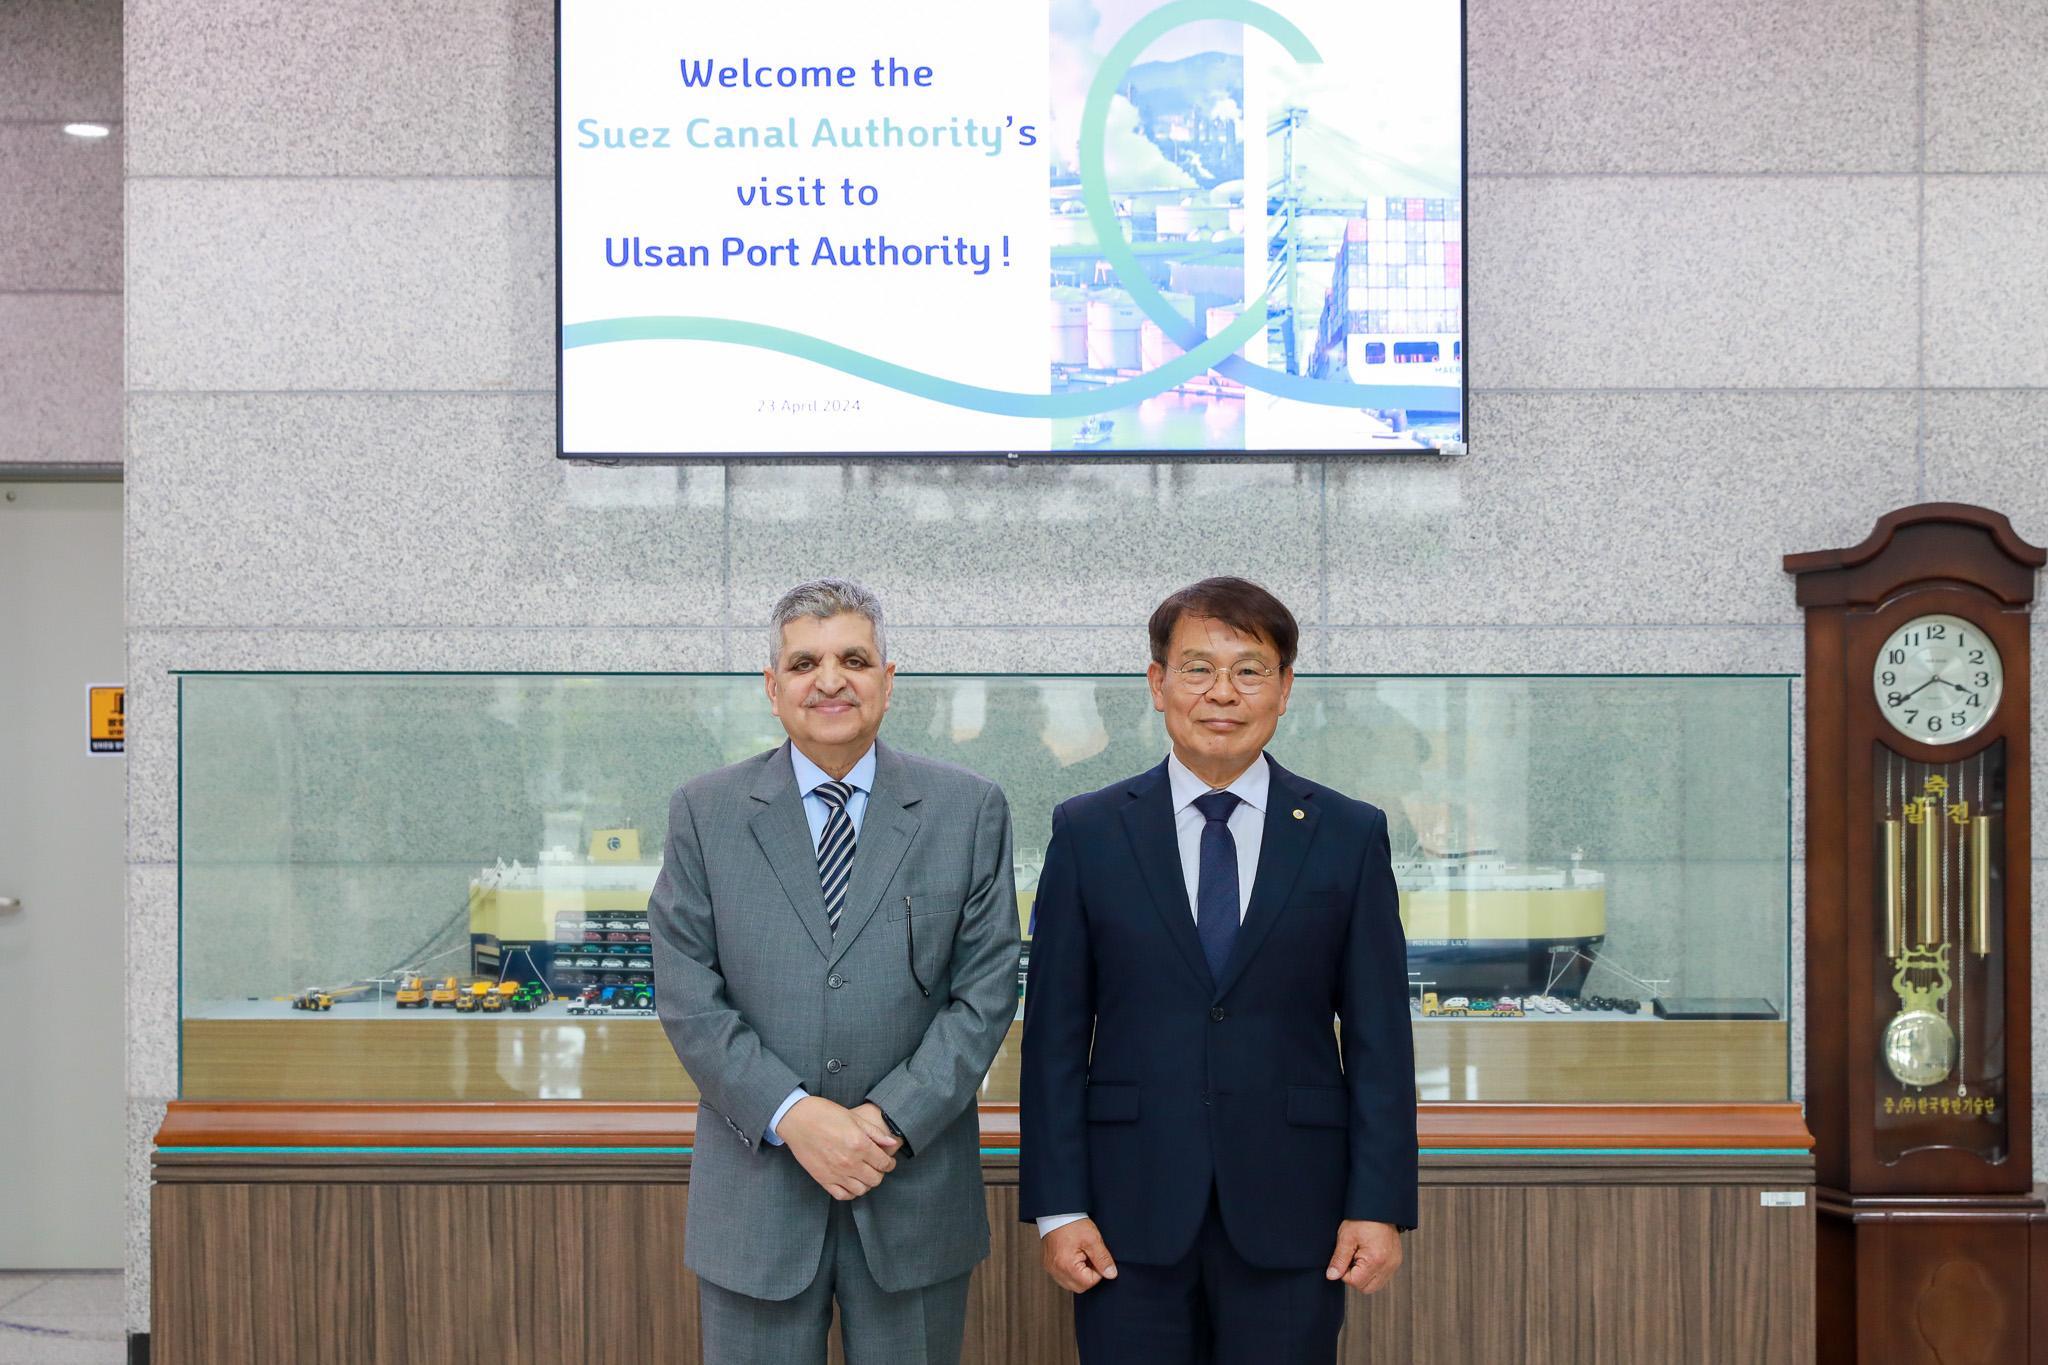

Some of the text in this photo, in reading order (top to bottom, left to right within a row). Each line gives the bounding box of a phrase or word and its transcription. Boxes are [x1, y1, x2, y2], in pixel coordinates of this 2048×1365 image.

[680, 57, 934, 89] Welcome the
[577, 115, 1037, 157] Suez Canal Authority's
[737, 176, 879, 206] visit to
[605, 236, 710, 268] Ulsan
[721, 237, 800, 268] Port
[757, 400, 861, 415] 23 April 2024
[1904, 632, 1919, 647] 11
[1926, 624, 1946, 640] 12
[1957, 632, 1965, 648] 1
[1889, 649, 1905, 665] 10
[1968, 650, 1985, 665] 2
[1881, 671, 1896, 687] 9
[1974, 671, 1990, 688] 3
[1887, 691, 1902, 708] 8
[1965, 694, 1981, 708] 4
[1903, 709, 1919, 725] 7
[1927, 716, 1942, 732] 6
[1951, 710, 1967, 726] 5
